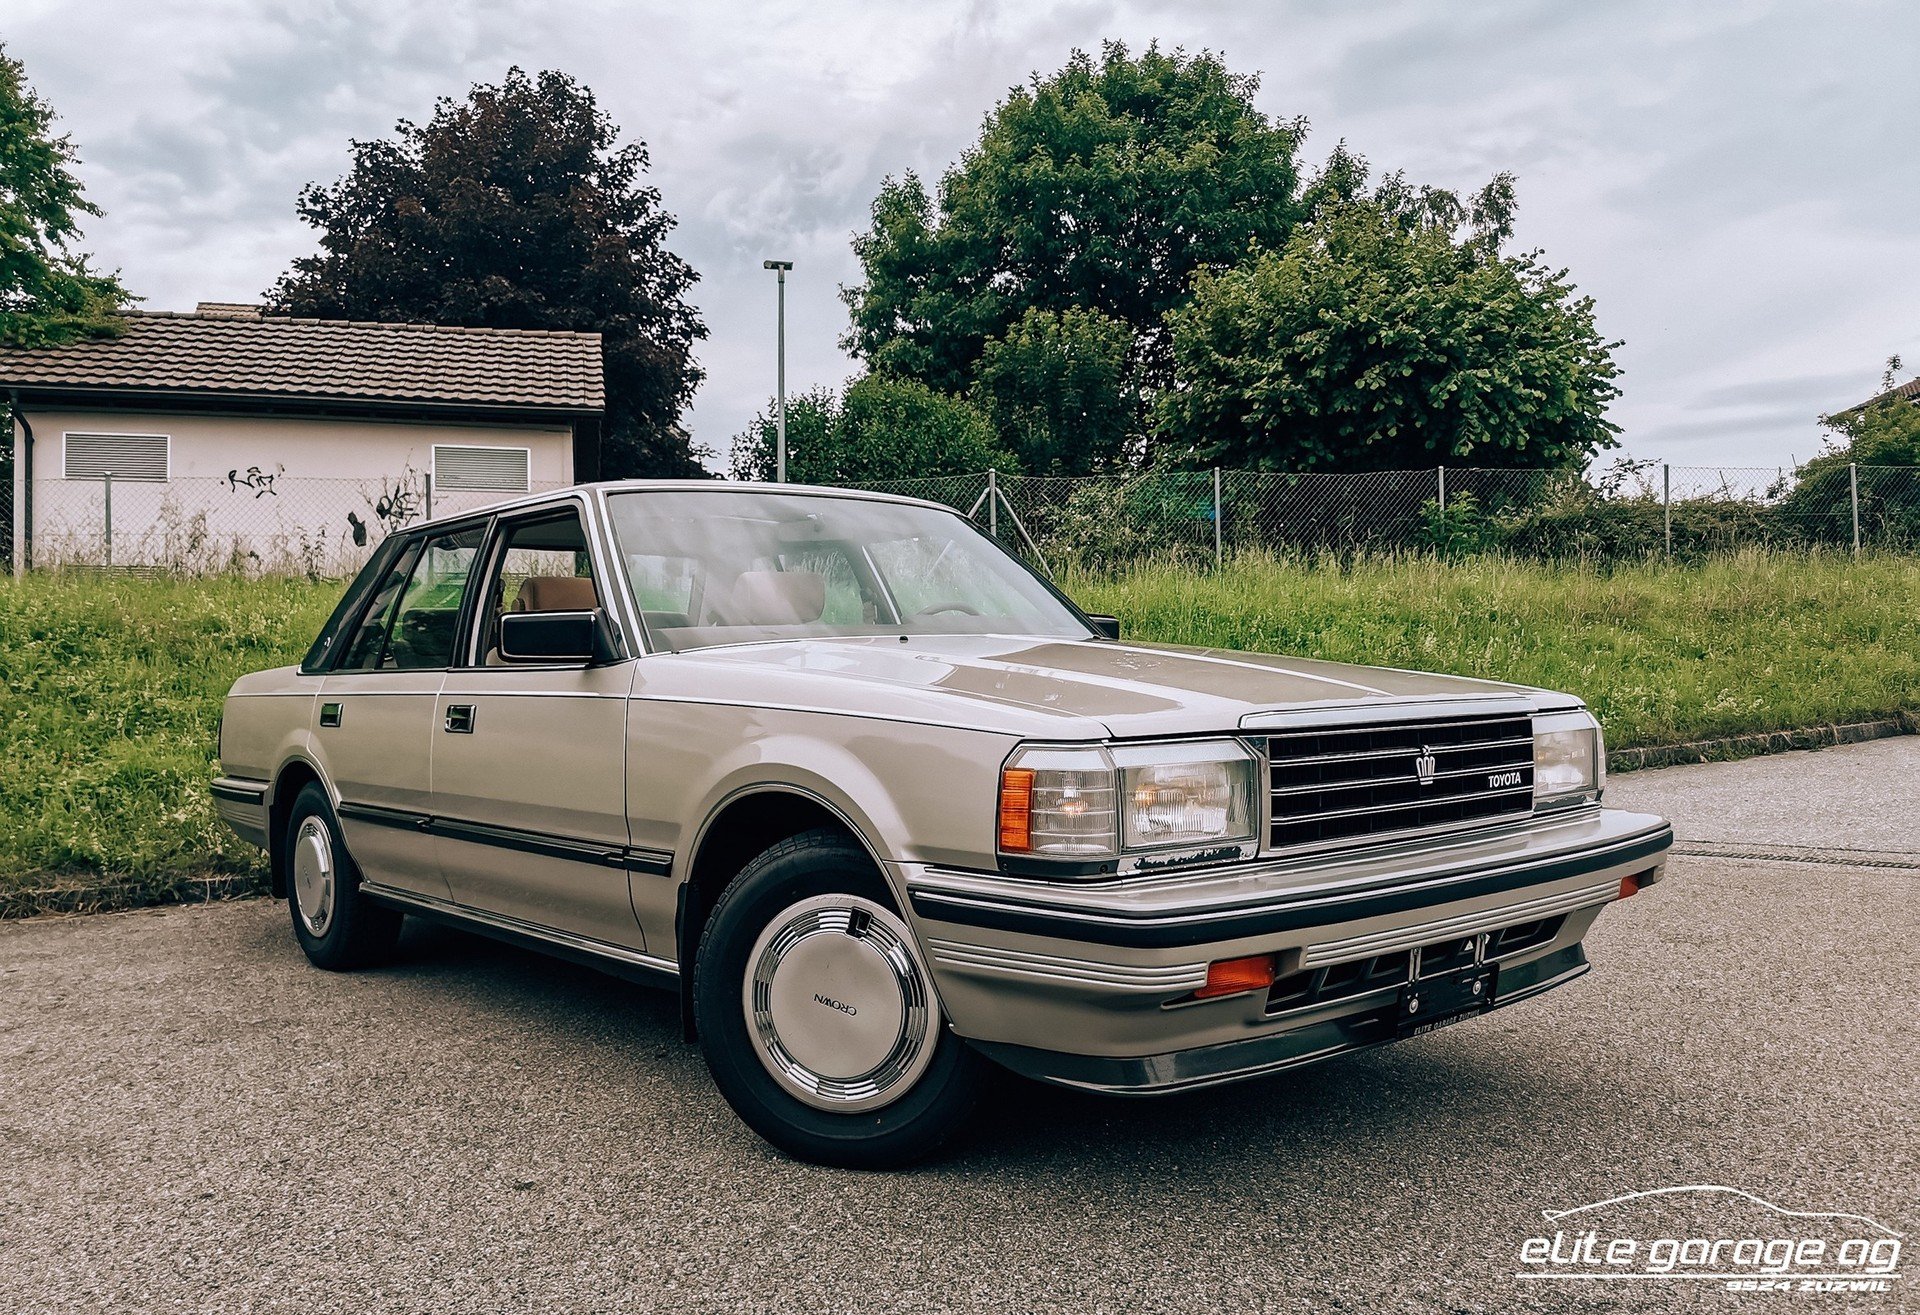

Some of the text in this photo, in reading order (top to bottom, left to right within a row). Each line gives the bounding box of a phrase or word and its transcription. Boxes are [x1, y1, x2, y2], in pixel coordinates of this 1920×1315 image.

[1488, 772, 1522, 788] TOYOTA
[813, 993, 858, 1017] CROWN
[1413, 1023, 1433, 1036] ELITE
[1433, 1015, 1458, 1030] GARAGE
